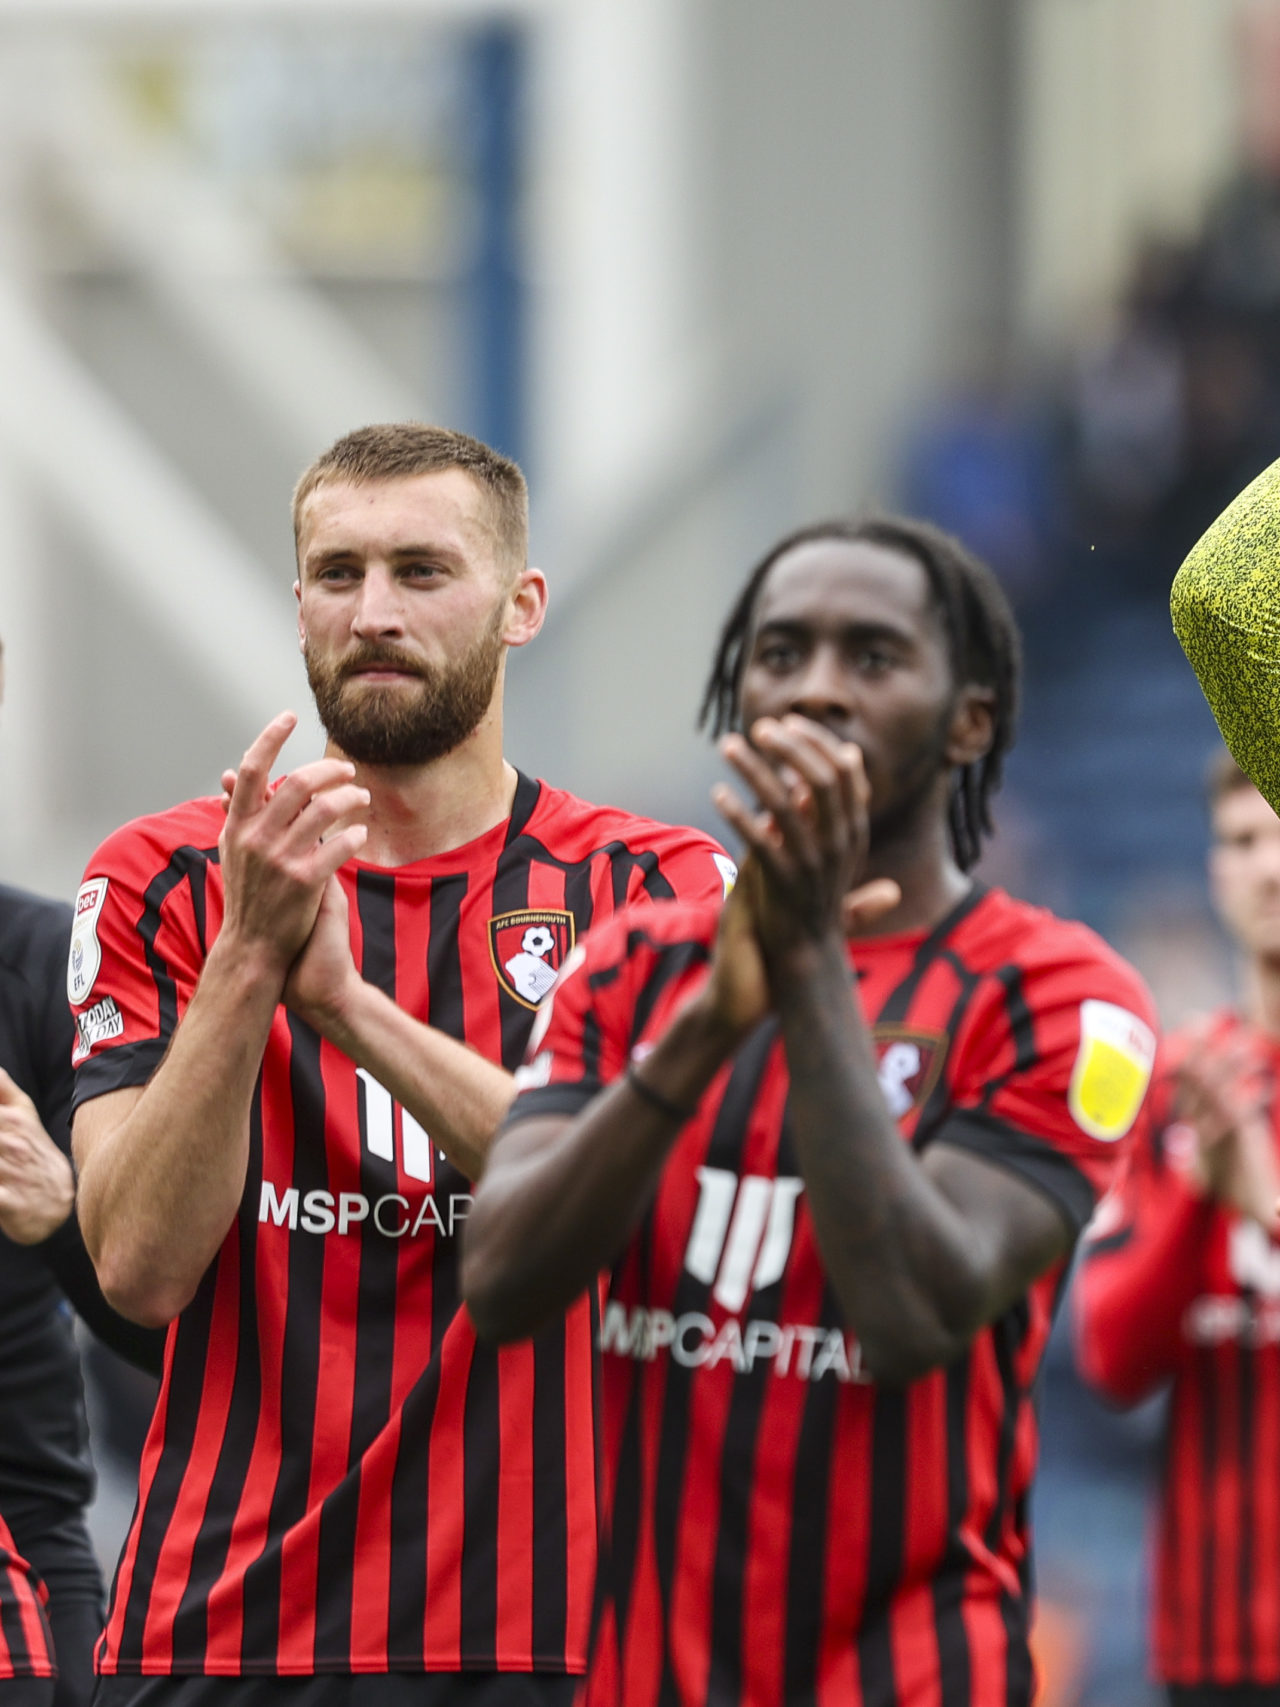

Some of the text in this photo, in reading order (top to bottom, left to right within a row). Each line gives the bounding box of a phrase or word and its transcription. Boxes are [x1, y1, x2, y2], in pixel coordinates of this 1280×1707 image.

[78, 892, 96, 912] bet
[496, 914, 566, 930] AFC BOURNEMOUTH
[73, 974, 85, 992] EFL
[78, 996, 117, 1032] TODAY
[598, 1299, 873, 1385] MPCAPITAL
